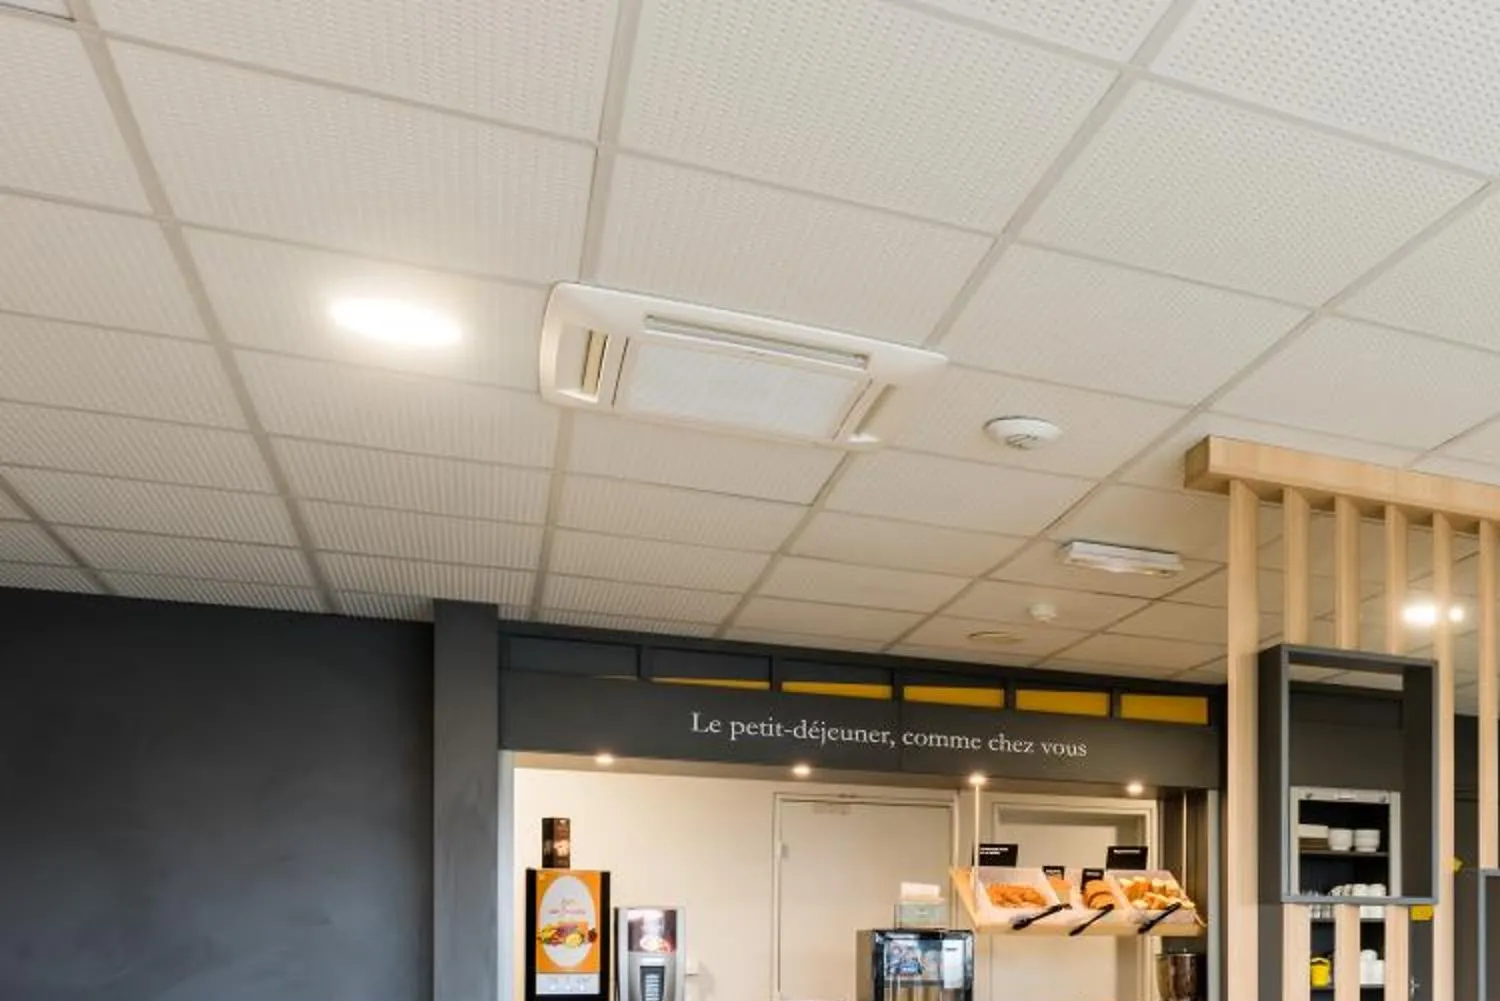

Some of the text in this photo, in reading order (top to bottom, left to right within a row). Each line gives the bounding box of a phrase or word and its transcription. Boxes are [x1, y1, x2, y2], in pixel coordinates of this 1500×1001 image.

[692, 711, 1087, 757] Le petit-déjeuner, comme chez vous
